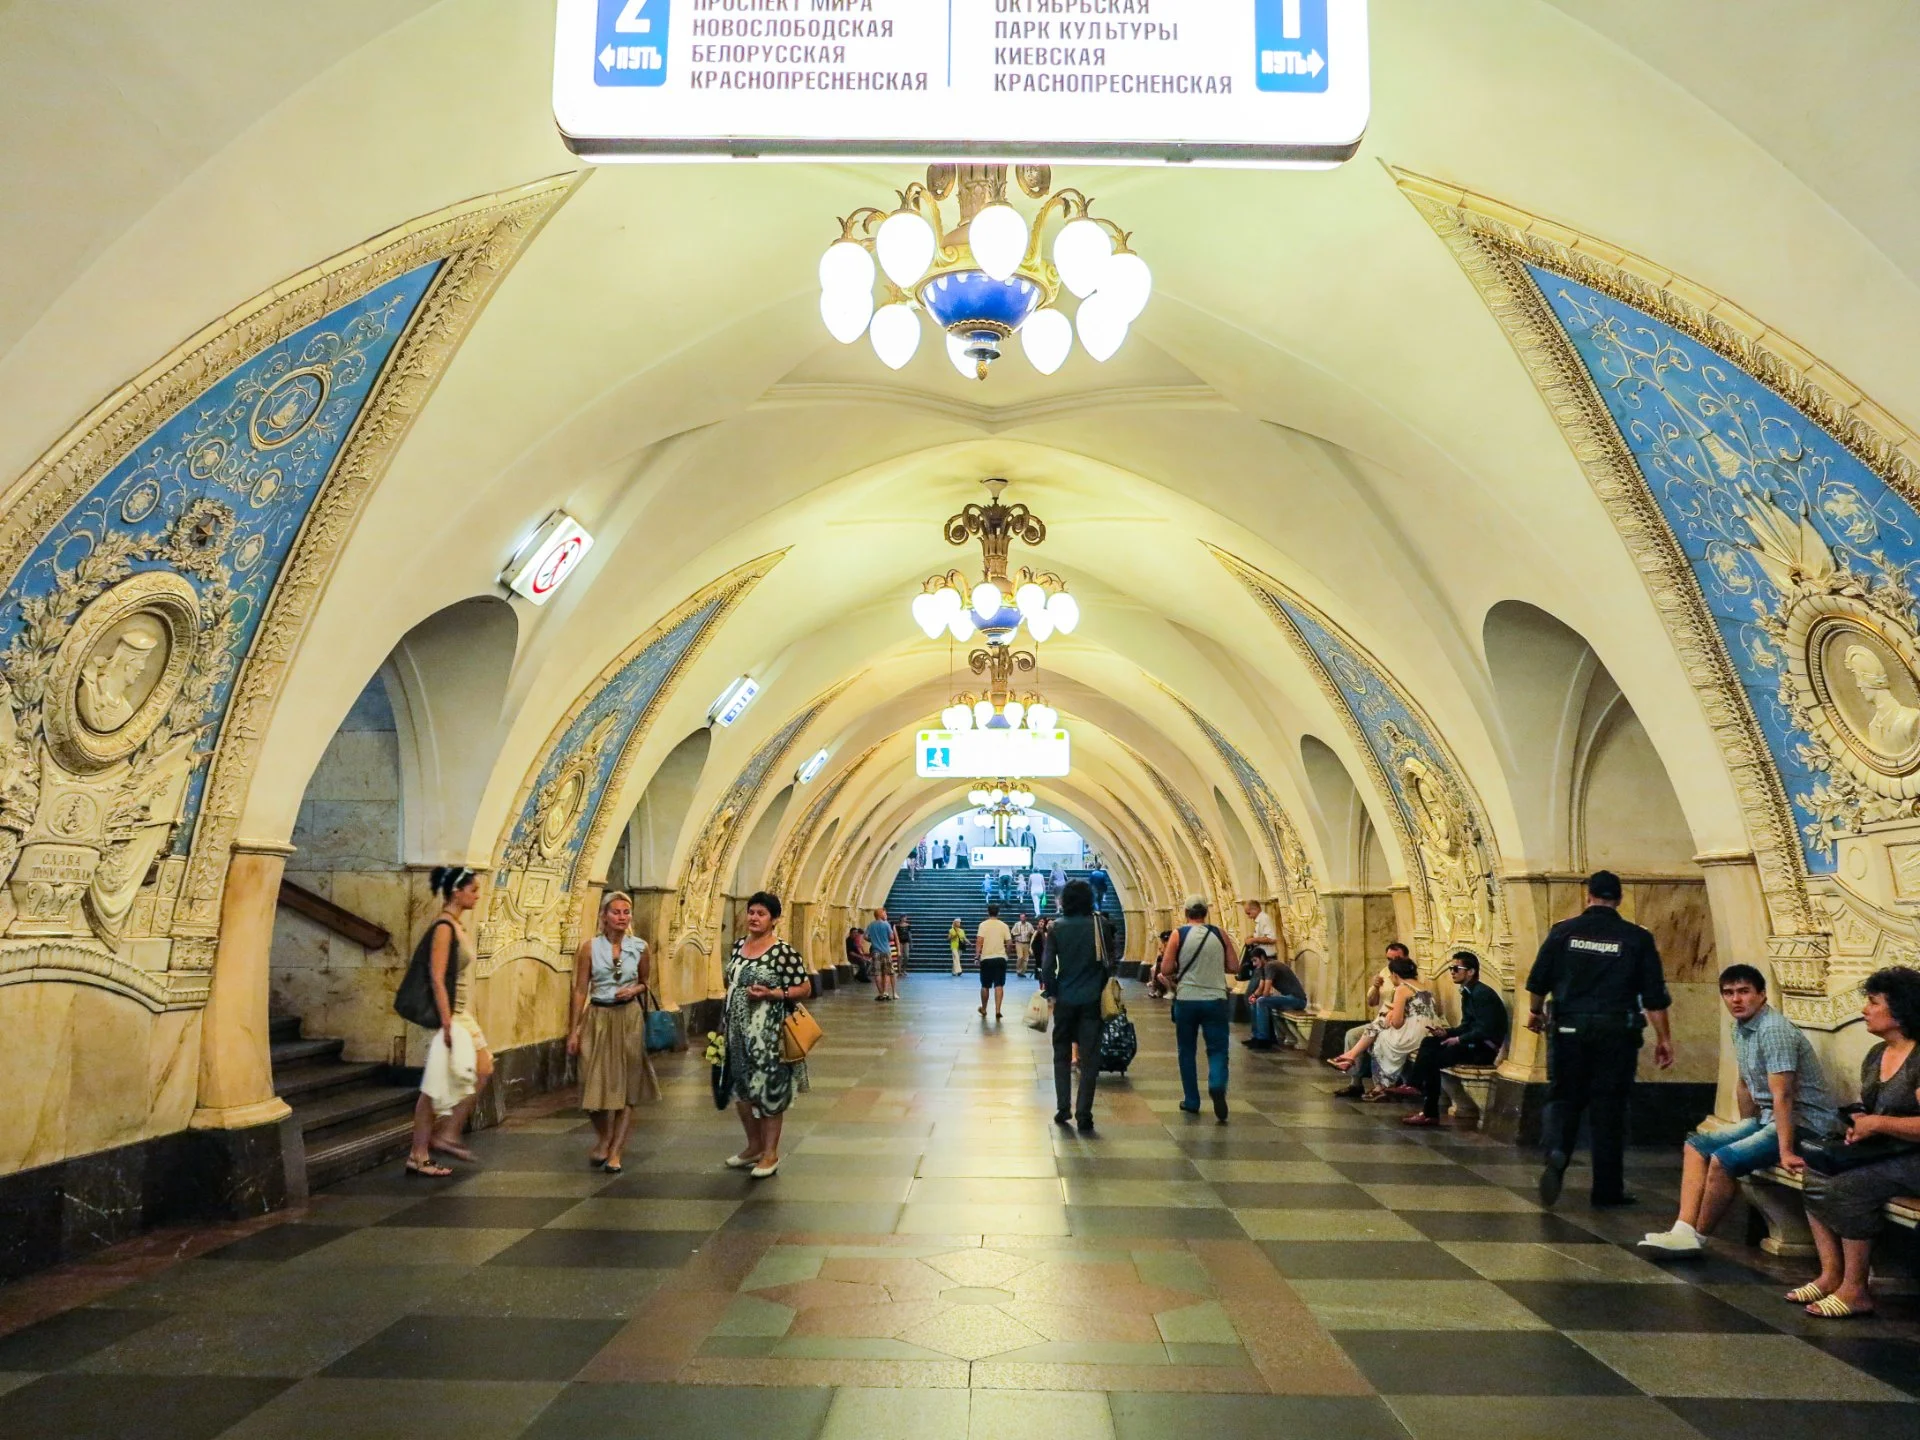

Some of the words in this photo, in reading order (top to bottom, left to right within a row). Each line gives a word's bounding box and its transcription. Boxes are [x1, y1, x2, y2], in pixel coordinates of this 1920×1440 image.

[694, 0, 799, 12] ПРОСПЕКТ
[811, 0, 873, 12] МИРА
[995, 0, 1149, 14] ОКТЯБРЬСКАЯ
[692, 18, 893, 40] НОВОСЛОБОДСКАЯ
[995, 20, 1050, 40] ПАРК
[1059, 21, 1178, 41] КУЛЬТУРЫ
[616, 46, 662, 70] ПУТЬ
[692, 44, 845, 64] БЕЛОРУССКАЯ
[995, 47, 1105, 67] КИЕВСКАЯ
[690, 70, 928, 91] КРАСНОПРЕСНЕНСКАЯ
[994, 73, 1232, 95] КРАСНОПРЕСНЕНСКАЯ
[1570, 939, 1619, 953] ПОЛИЦИЯ
